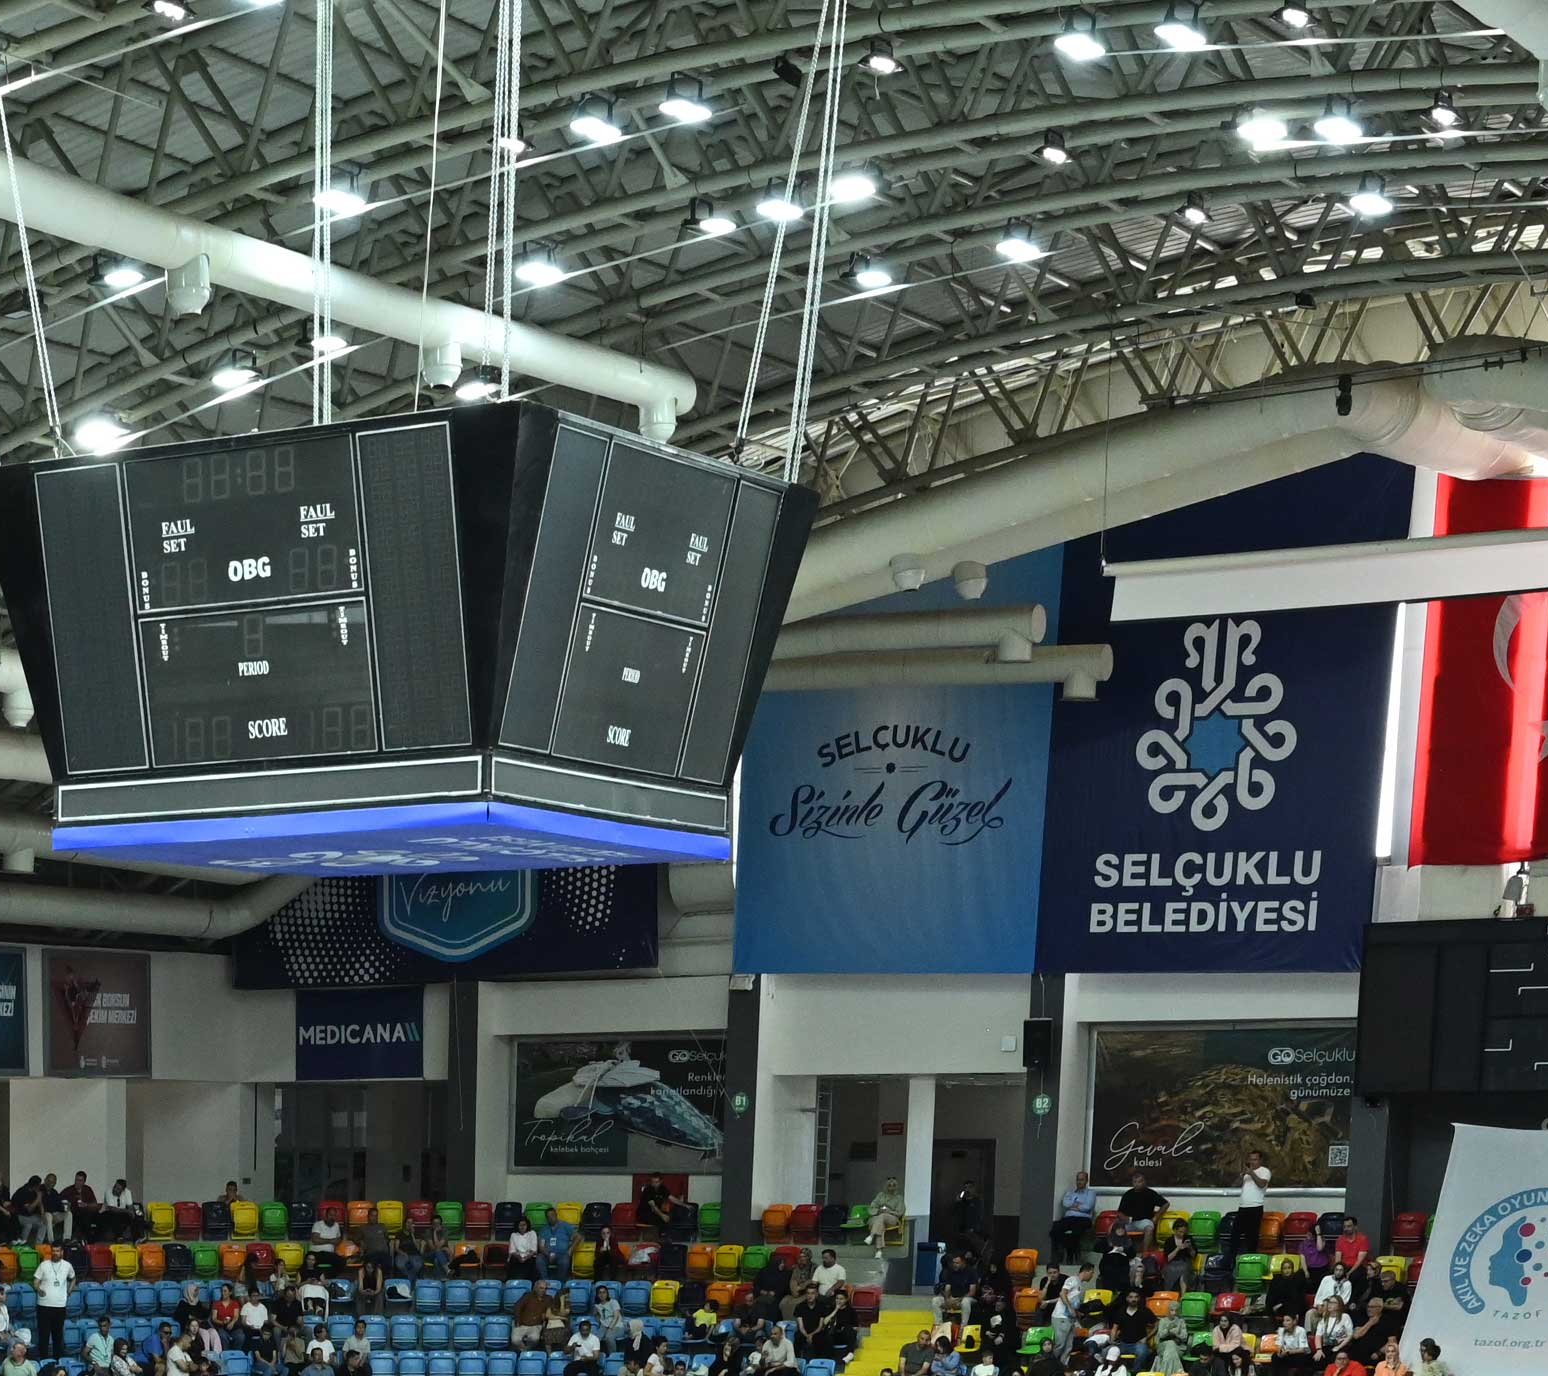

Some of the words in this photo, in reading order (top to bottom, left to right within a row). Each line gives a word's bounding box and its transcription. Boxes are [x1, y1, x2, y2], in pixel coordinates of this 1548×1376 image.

[300, 503, 335, 520] FAUL
[161, 519, 195, 536] FAUL
[301, 523, 326, 538] SET
[615, 512, 635, 531] FAUL
[163, 538, 187, 553] SET
[611, 530, 628, 546] SET
[689, 533, 709, 551] FAUL
[686, 550, 702, 566] SET
[228, 555, 272, 582] OBG
[641, 566, 667, 592] OBG
[238, 660, 270, 676] PERIOD
[248, 717, 288, 739] SCORE
[606, 725, 632, 747] SCORE
[817, 724, 971, 767] SELÇUKLU
[769, 781, 885, 839] Sizinle
[897, 777, 1013, 846] Güzel
[1094, 850, 1322, 896] SELÇUKLU
[400, 873, 511, 922] Vizyonu
[1089, 892, 1319, 933] BELEDİYESİ
[299, 1021, 406, 1045] MEDICANA
[1248, 1072, 1303, 1086] Helenistik
[1305, 1072, 1354, 1087] çağdan,
[1289, 1087, 1351, 1100] günümüze
[1035, 1098, 1049, 1109] B2
[1134, 1157, 1163, 1168] kalesi
[1460, 1214, 1497, 1252] ZEKA
[1453, 1252, 1470, 1277] VE
[1455, 1279, 1482, 1309] AKIL
[1493, 1309, 1543, 1321] TAZOF
[1473, 1338, 1546, 1350] tazof.org.tr
